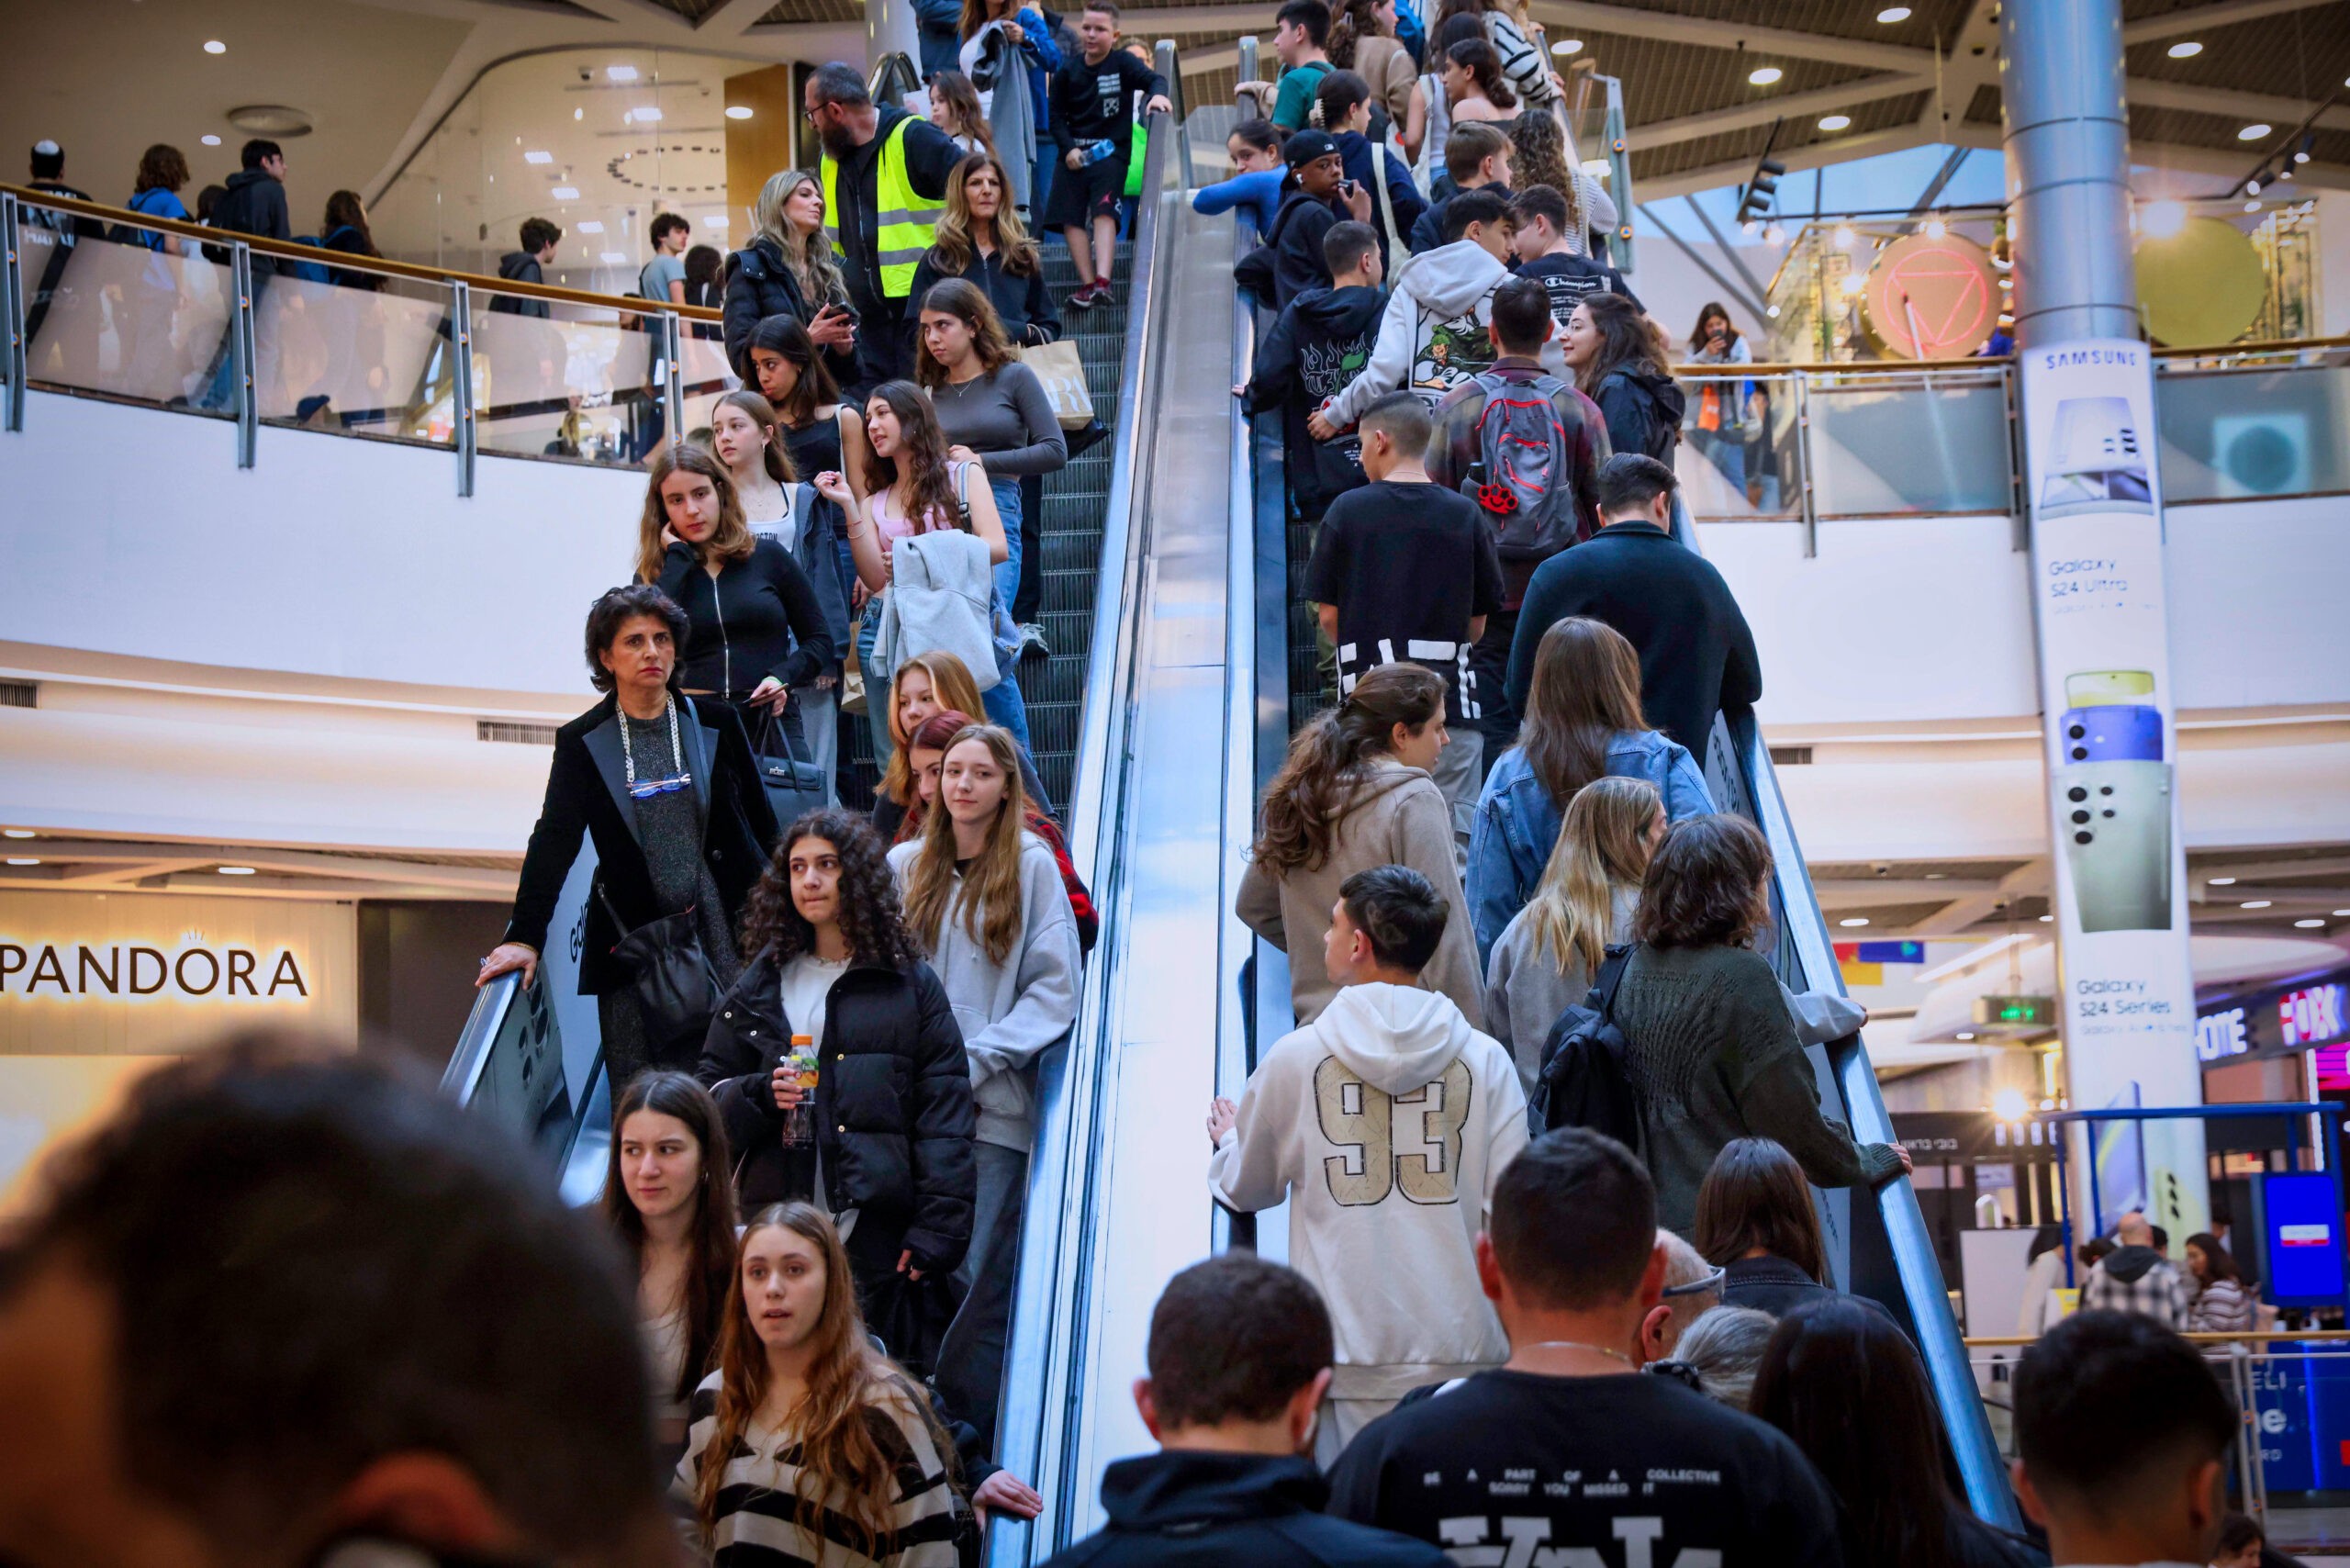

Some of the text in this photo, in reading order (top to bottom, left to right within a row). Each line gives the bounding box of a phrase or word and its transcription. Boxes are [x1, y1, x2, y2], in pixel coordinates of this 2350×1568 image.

[1544, 277, 1596, 290] Champion
[2049, 559, 2116, 576] Galaxy
[2051, 581, 2078, 598] S24
[0, 944, 308, 996] PANDORA
[2077, 979, 2145, 994] Galaxy
[2079, 1000, 2171, 1017] S24 Series
[2279, 983, 2341, 1047] FOX
[1313, 1054, 1472, 1207] 93
[1468, 1469, 1478, 1480] A
[1505, 1469, 1536, 1480] PART
[1563, 1470, 1581, 1482] OF
[1609, 1470, 1619, 1480] A
[1647, 1469, 1720, 1483] COLLECTIVE
[1489, 1482, 1655, 1495] SORRY YOU MISSED IT
